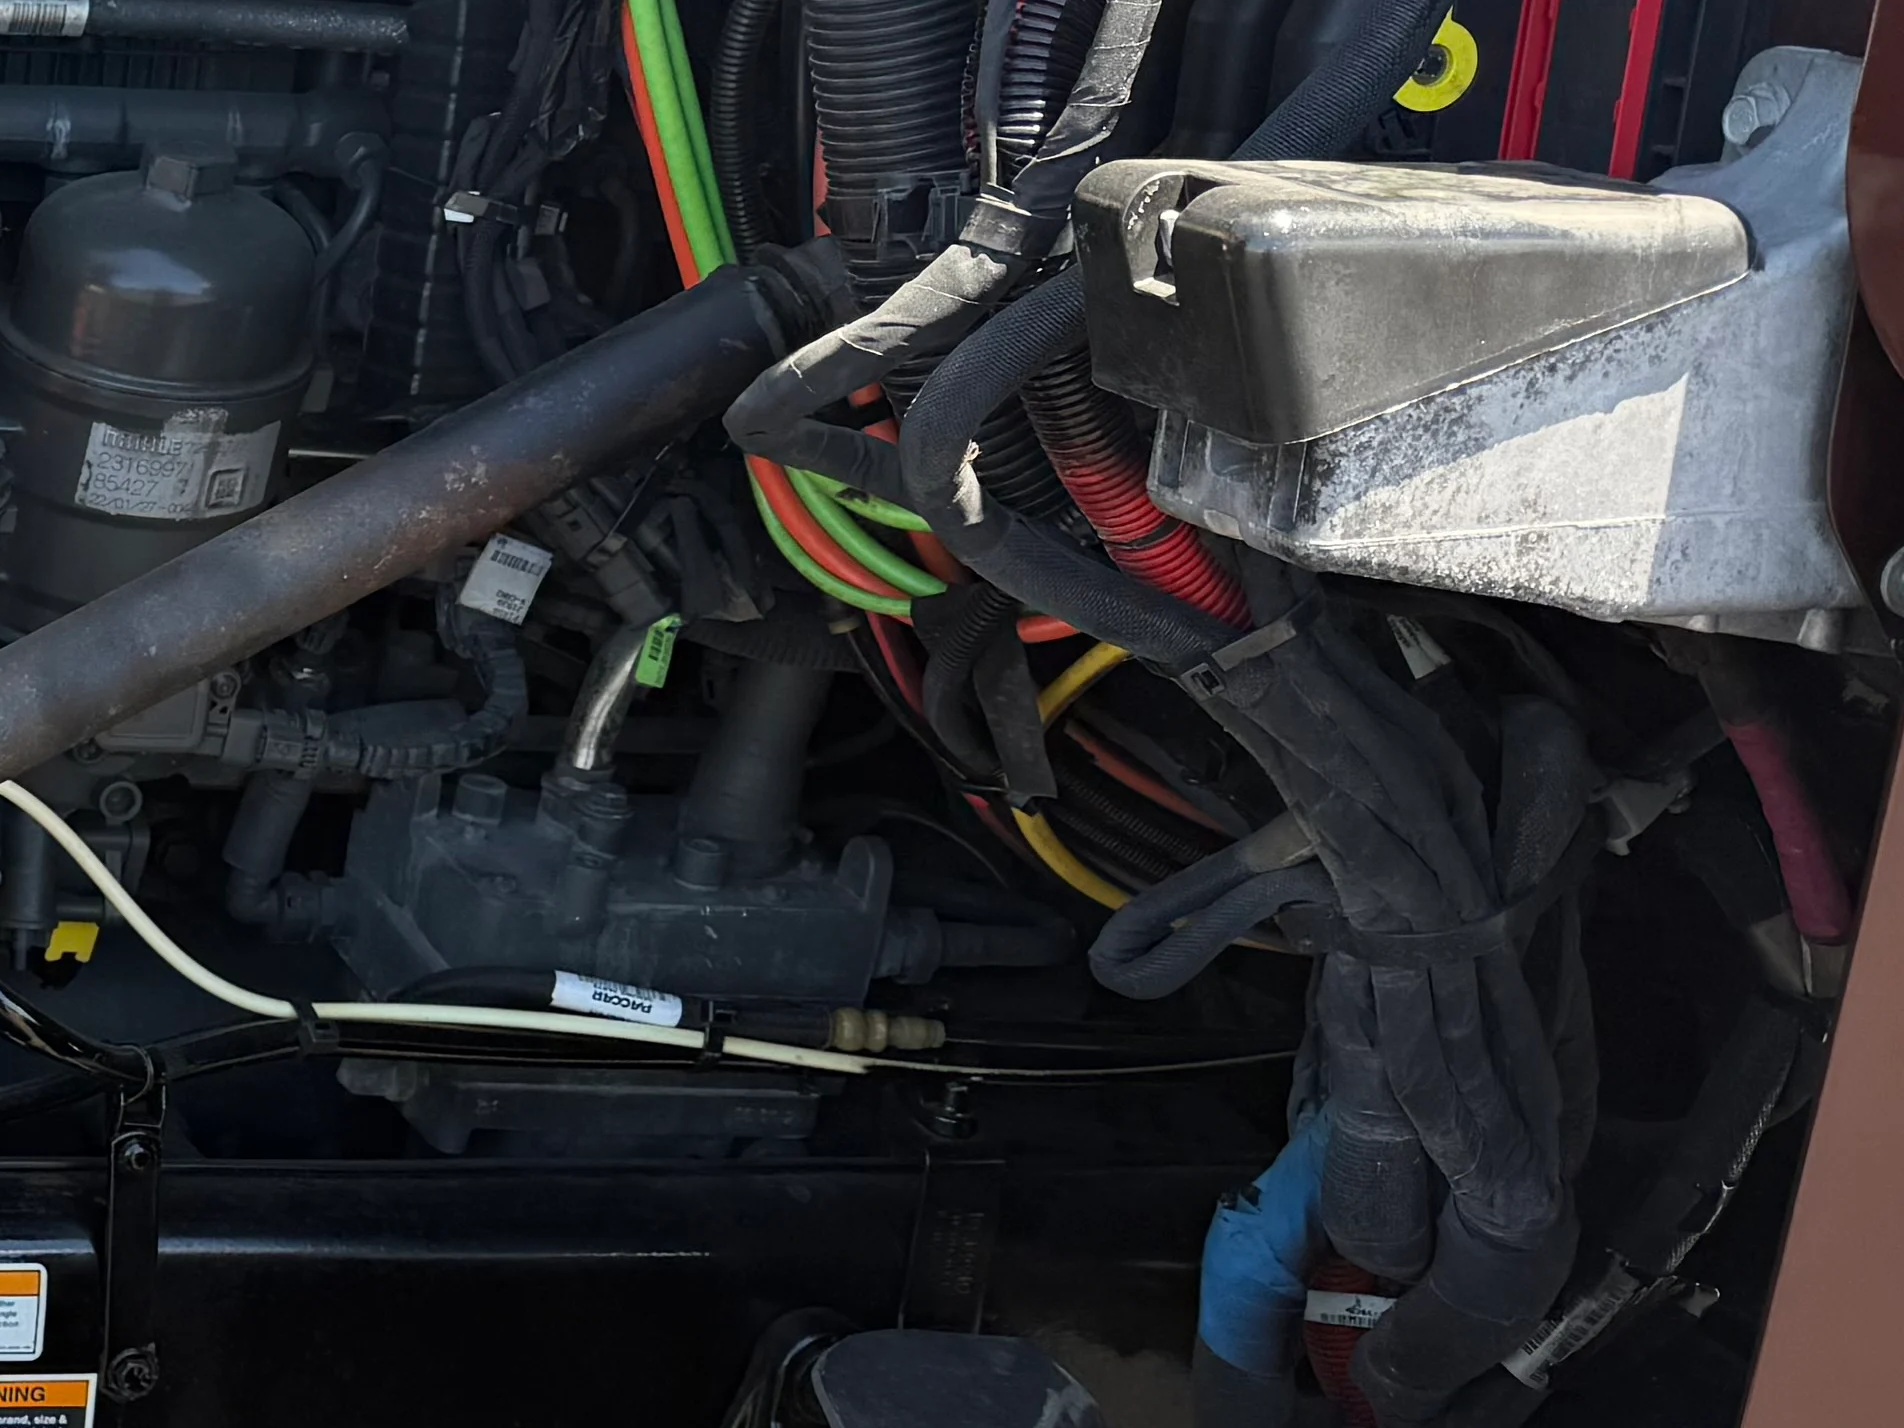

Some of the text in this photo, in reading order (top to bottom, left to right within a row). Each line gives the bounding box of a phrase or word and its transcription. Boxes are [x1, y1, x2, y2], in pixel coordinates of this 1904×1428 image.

[93, 472, 159, 497] 85427
[591, 990, 653, 1014] PACCAR
[34, 1415, 56, 1425] size
[59, 1415, 67, 1425] &
